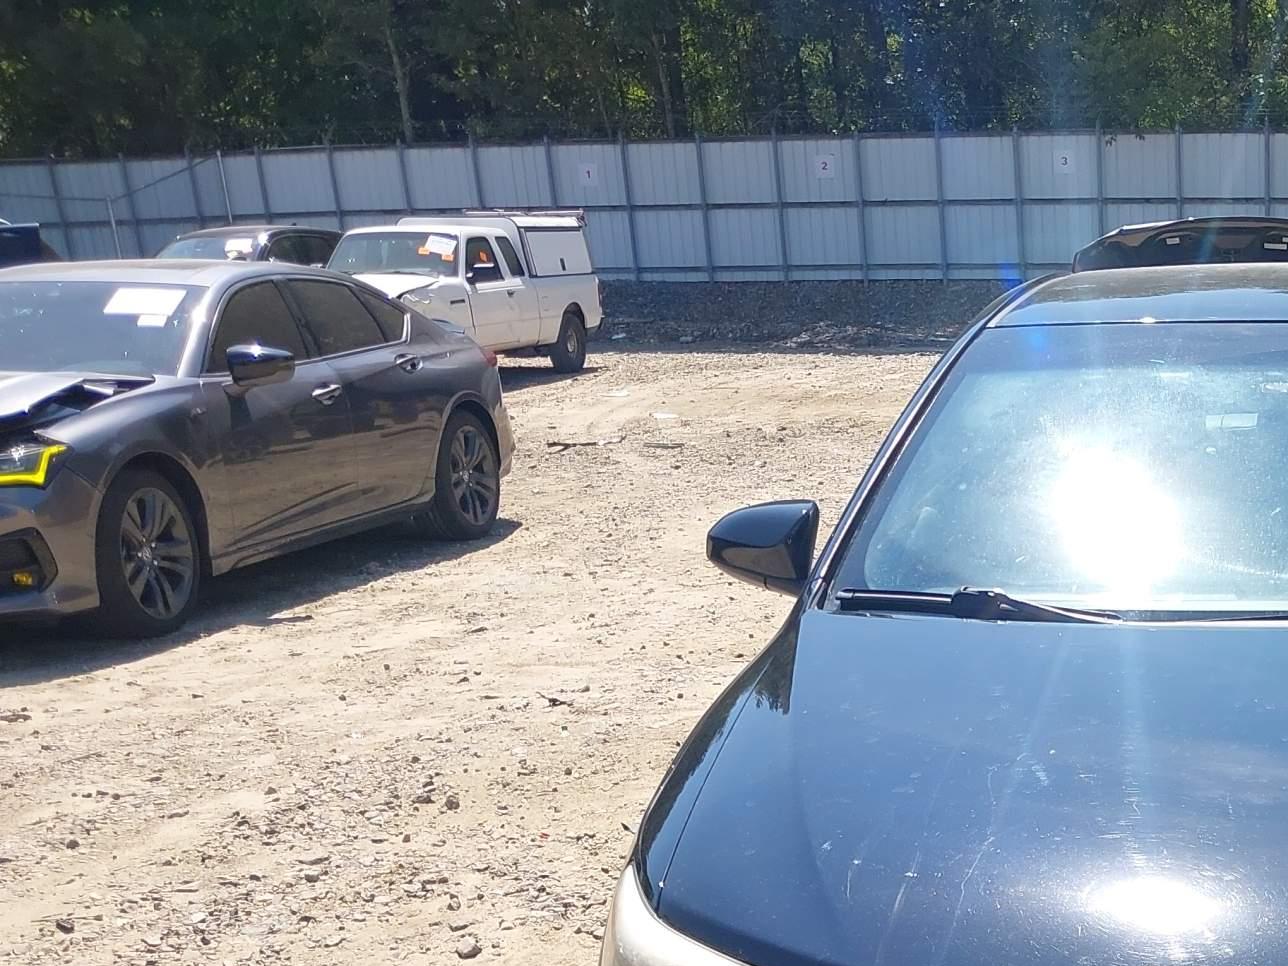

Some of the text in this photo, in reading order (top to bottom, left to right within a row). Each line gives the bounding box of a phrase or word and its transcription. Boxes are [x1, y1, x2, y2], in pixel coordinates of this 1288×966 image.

[820, 161, 829, 171] 2
[1060, 156, 1068, 166] 3
[585, 170, 592, 179] 1
